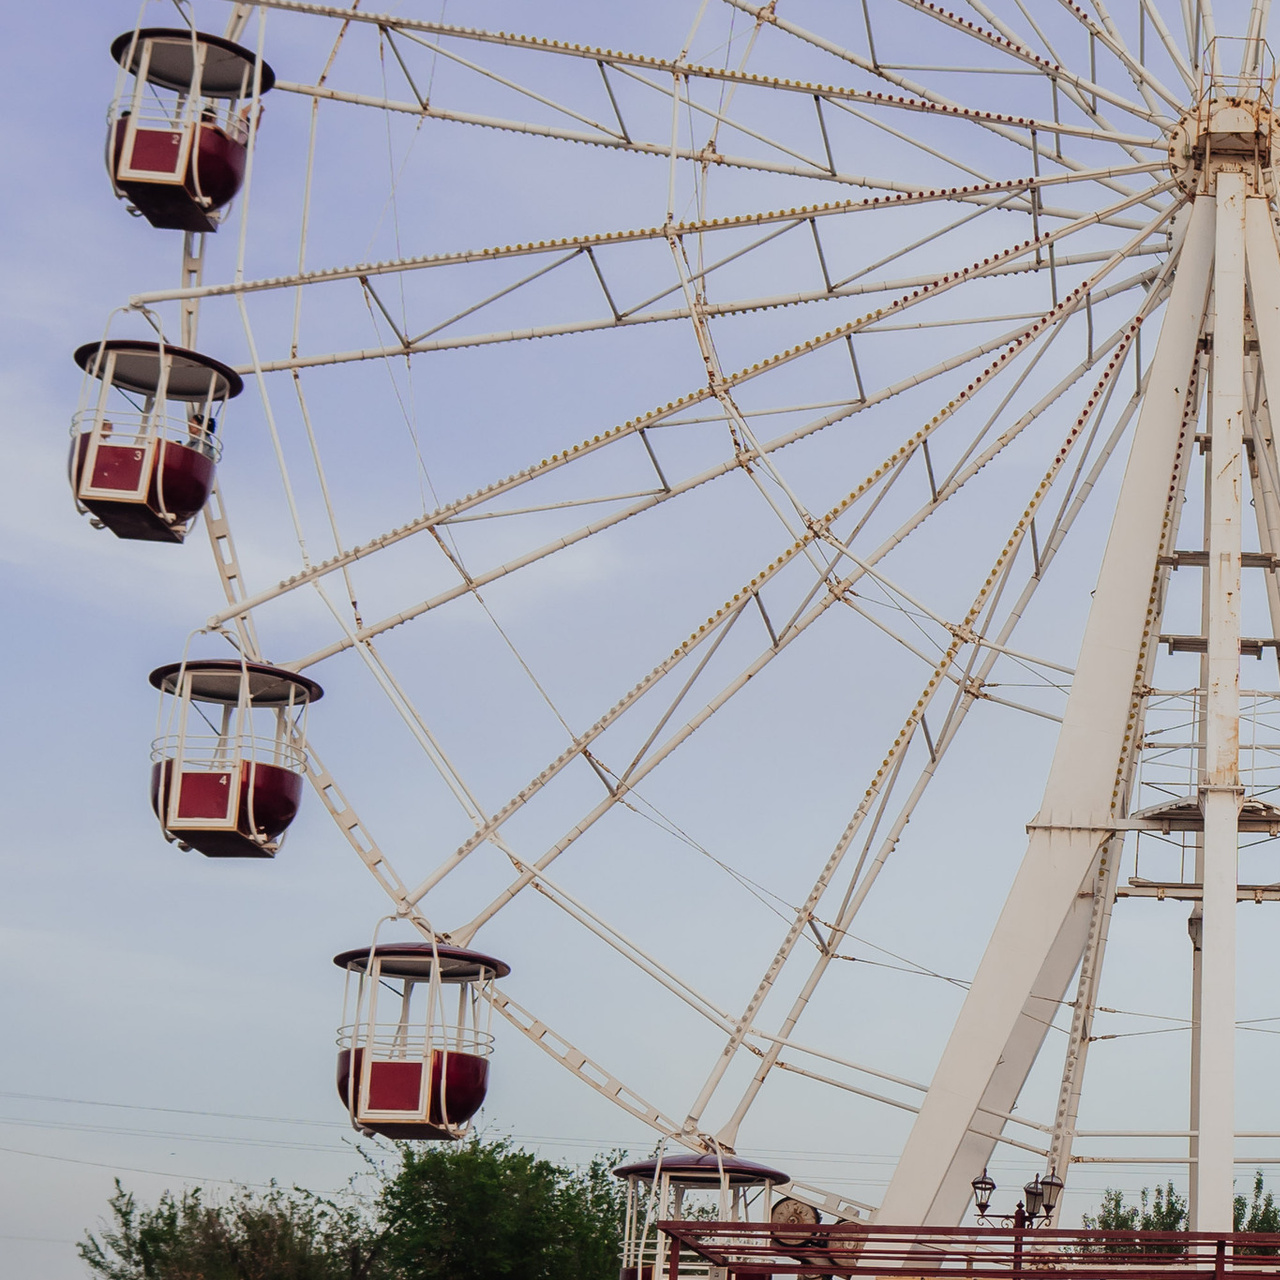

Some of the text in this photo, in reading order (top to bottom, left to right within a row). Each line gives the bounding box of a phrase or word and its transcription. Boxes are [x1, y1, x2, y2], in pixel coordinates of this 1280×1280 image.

[172, 134, 180, 145] 2
[133, 450, 142, 461] 3
[219, 775, 227, 785] 4
